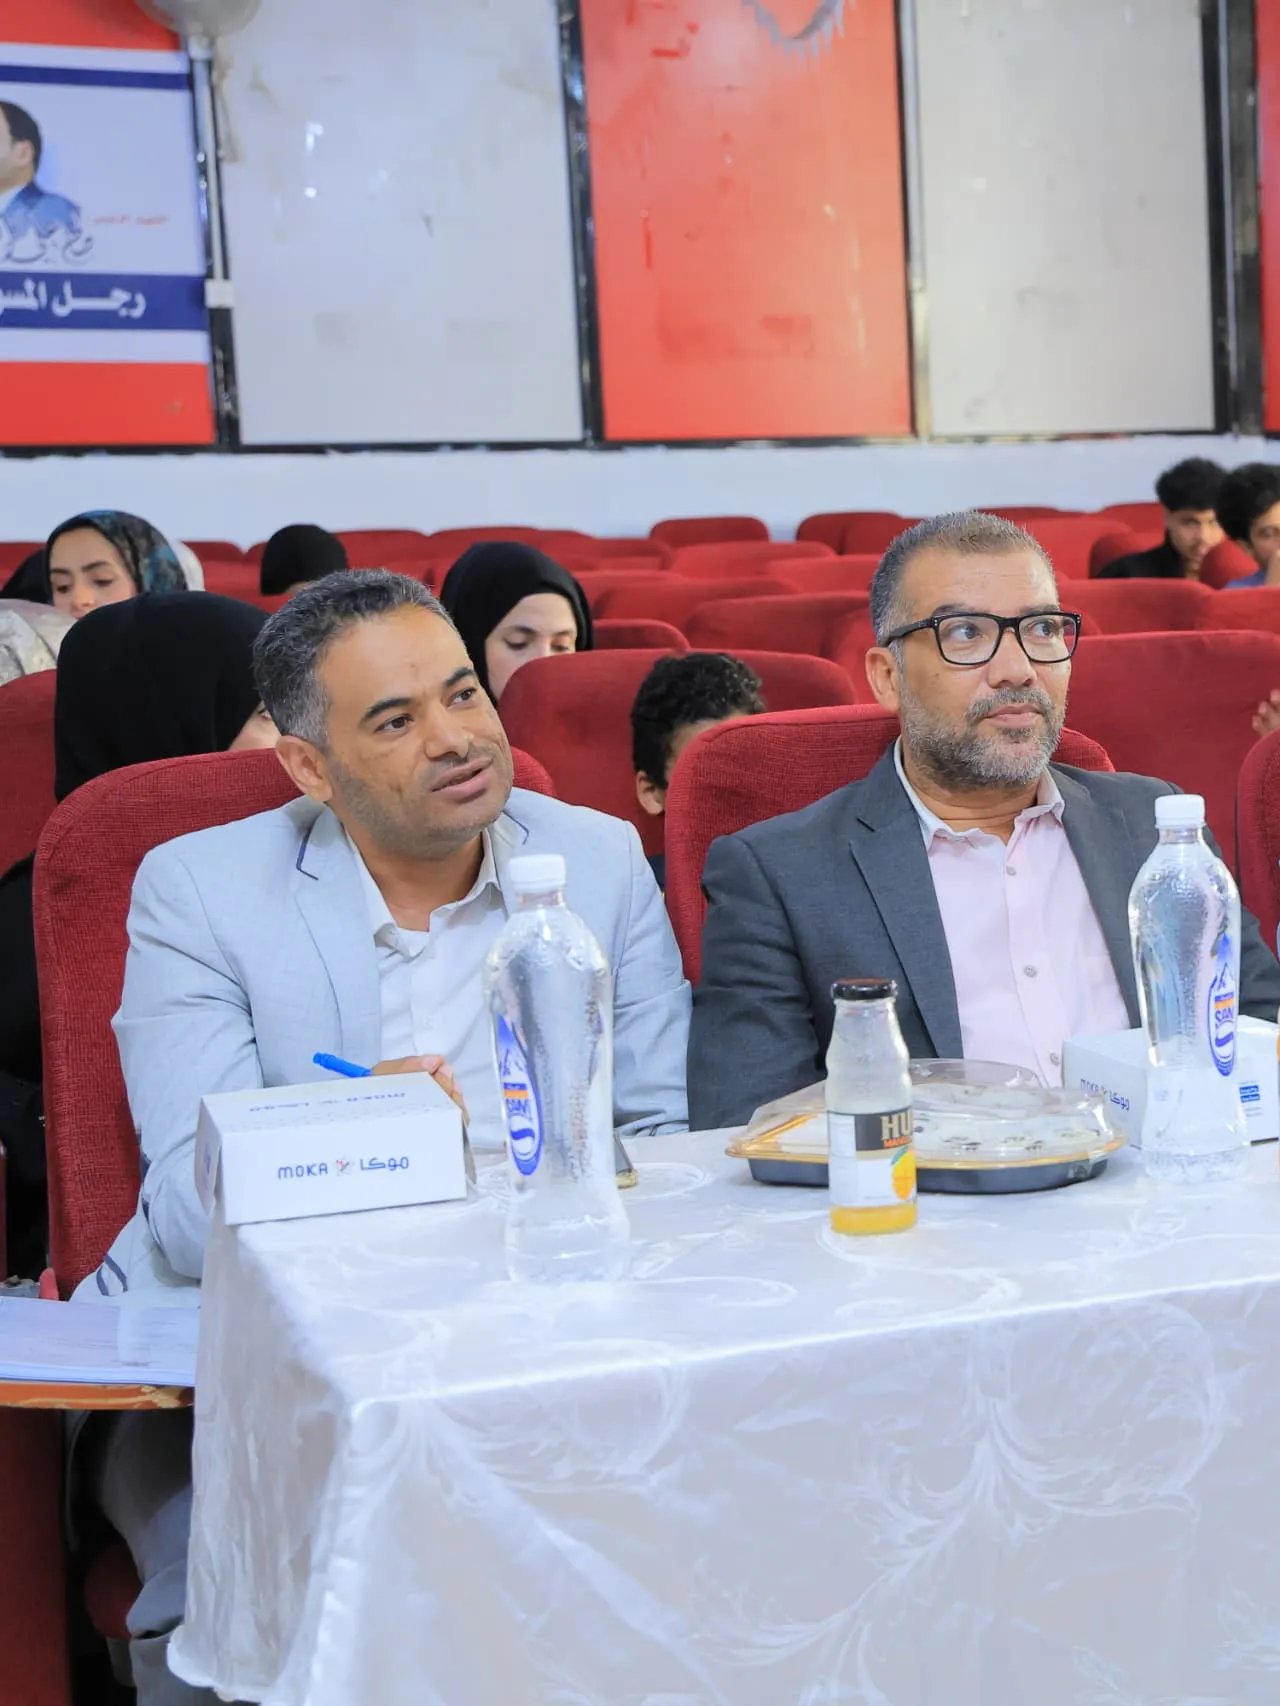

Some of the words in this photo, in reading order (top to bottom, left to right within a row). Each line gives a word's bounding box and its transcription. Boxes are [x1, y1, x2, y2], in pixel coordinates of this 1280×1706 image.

[51, 279, 147, 319] رجل
[277, 1162, 329, 1180] MOKA
[360, 1156, 410, 1172] موكا
